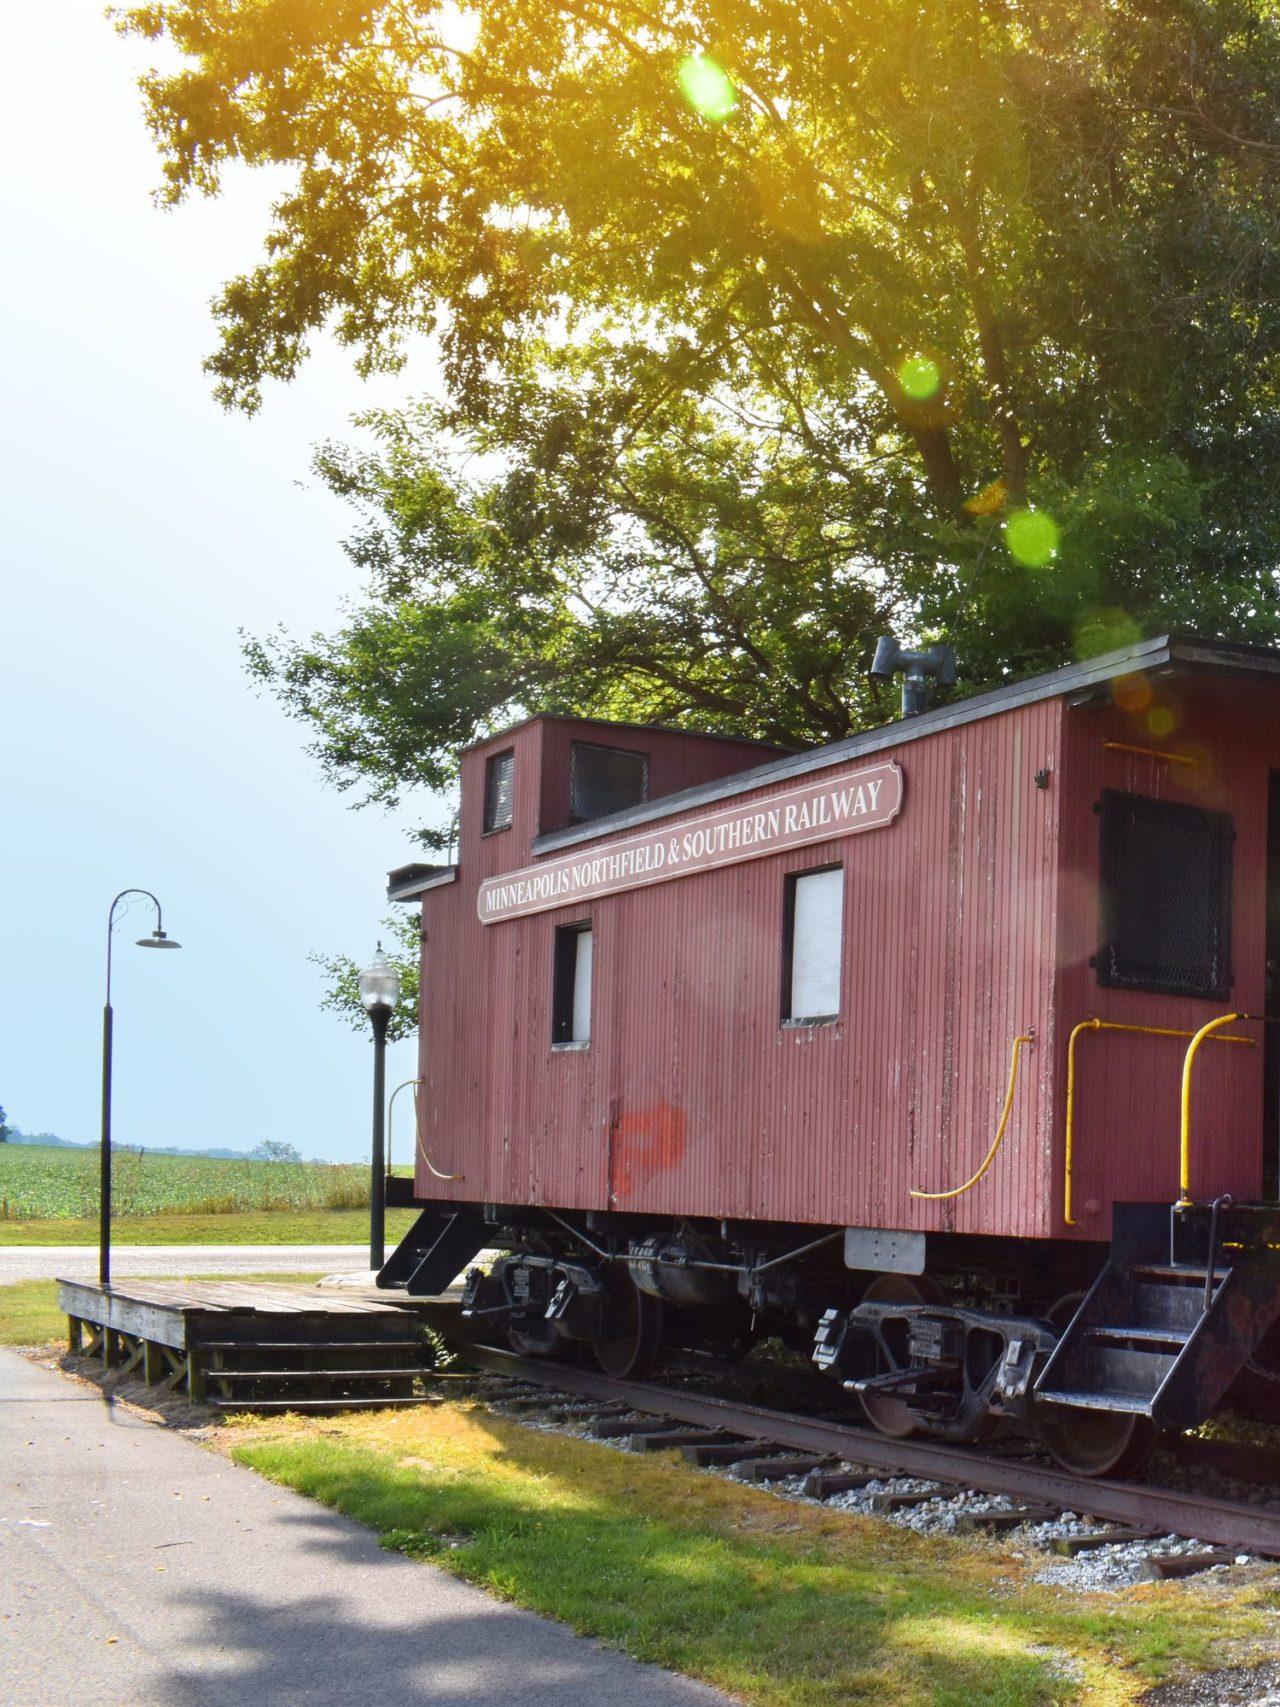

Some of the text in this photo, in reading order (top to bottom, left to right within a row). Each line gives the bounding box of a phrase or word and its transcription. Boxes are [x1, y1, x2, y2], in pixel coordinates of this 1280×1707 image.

[486, 779, 883, 913] MINNEAPOLIS NORTHFIELD & SOUTHERN RAILWAY
